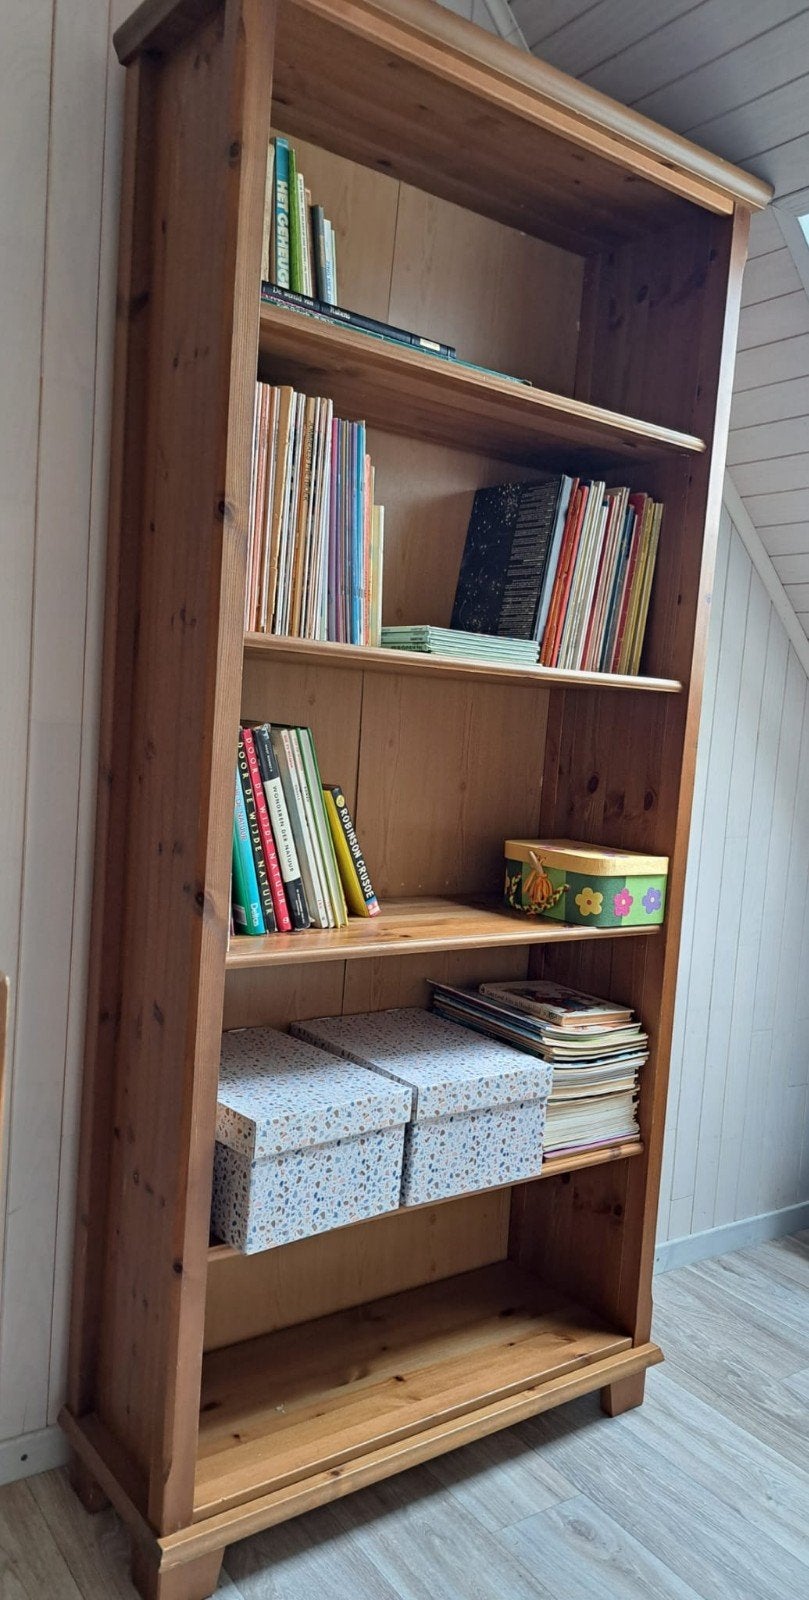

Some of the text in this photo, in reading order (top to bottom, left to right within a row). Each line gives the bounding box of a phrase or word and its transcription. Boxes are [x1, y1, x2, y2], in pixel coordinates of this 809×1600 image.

[277, 180, 288, 212] HET
[273, 286, 281, 295] De
[304, 298, 314, 307] van
[238, 741, 249, 779] DOOR
[245, 788, 254, 803] DE
[246, 737, 286, 904] DOOR DE WIJDE NATUUR
[249, 812, 262, 852] WIJDE
[272, 786, 285, 827] WONDEREN
[284, 844, 295, 872] NATUUR
[340, 807, 375, 899] ROBINSON CRUSOE
[257, 860, 273, 915] NATUUR
